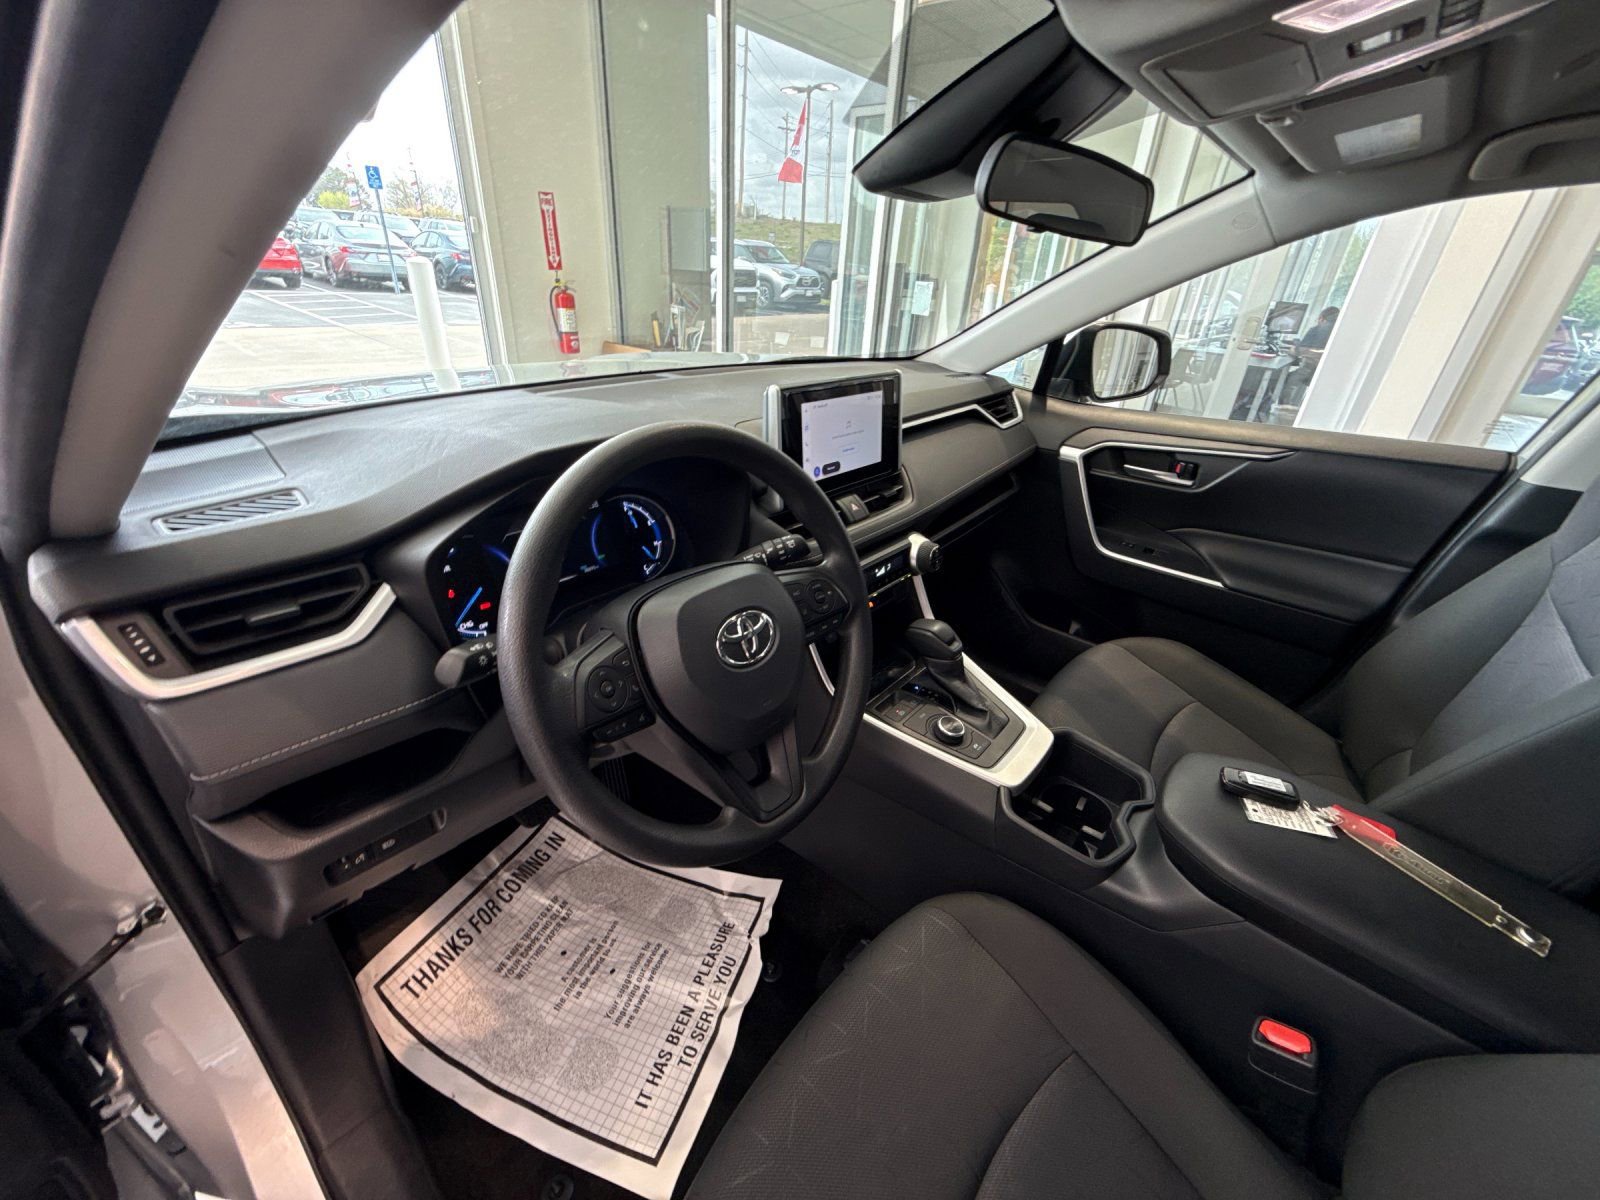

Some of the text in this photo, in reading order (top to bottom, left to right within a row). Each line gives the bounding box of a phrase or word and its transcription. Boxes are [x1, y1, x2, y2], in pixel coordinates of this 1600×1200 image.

[541, 198, 553, 206] FIRE
[546, 209, 557, 263] EXTINGUISHER
[400, 831, 566, 999] THANKS FOR COMING IN
[494, 960, 507, 973] WE
[505, 942, 524, 961] HAVE
[520, 921, 540, 941] TRIED
[537, 911, 547, 921] TO
[502, 900, 569, 979] YOUR CARPETING CLEAN
[515, 908, 574, 980] WITH THIS PAPER MAT
[553, 920, 619, 1012] the most important person
[566, 944, 591, 976] customer
[573, 990, 583, 1000] in
[579, 977, 591, 990] the
[589, 956, 605, 976] world
[602, 948, 611, 957] to
[603, 941, 652, 1020] Your suggestions for
[612, 942, 662, 1027] improving our service
[624, 1015, 636, 1029] are
[633, 984, 651, 1015] always
[634, 921, 735, 1109] IT HAS BEEN A PLEASURE
[677, 956, 737, 1068] TO SERVE YOU
